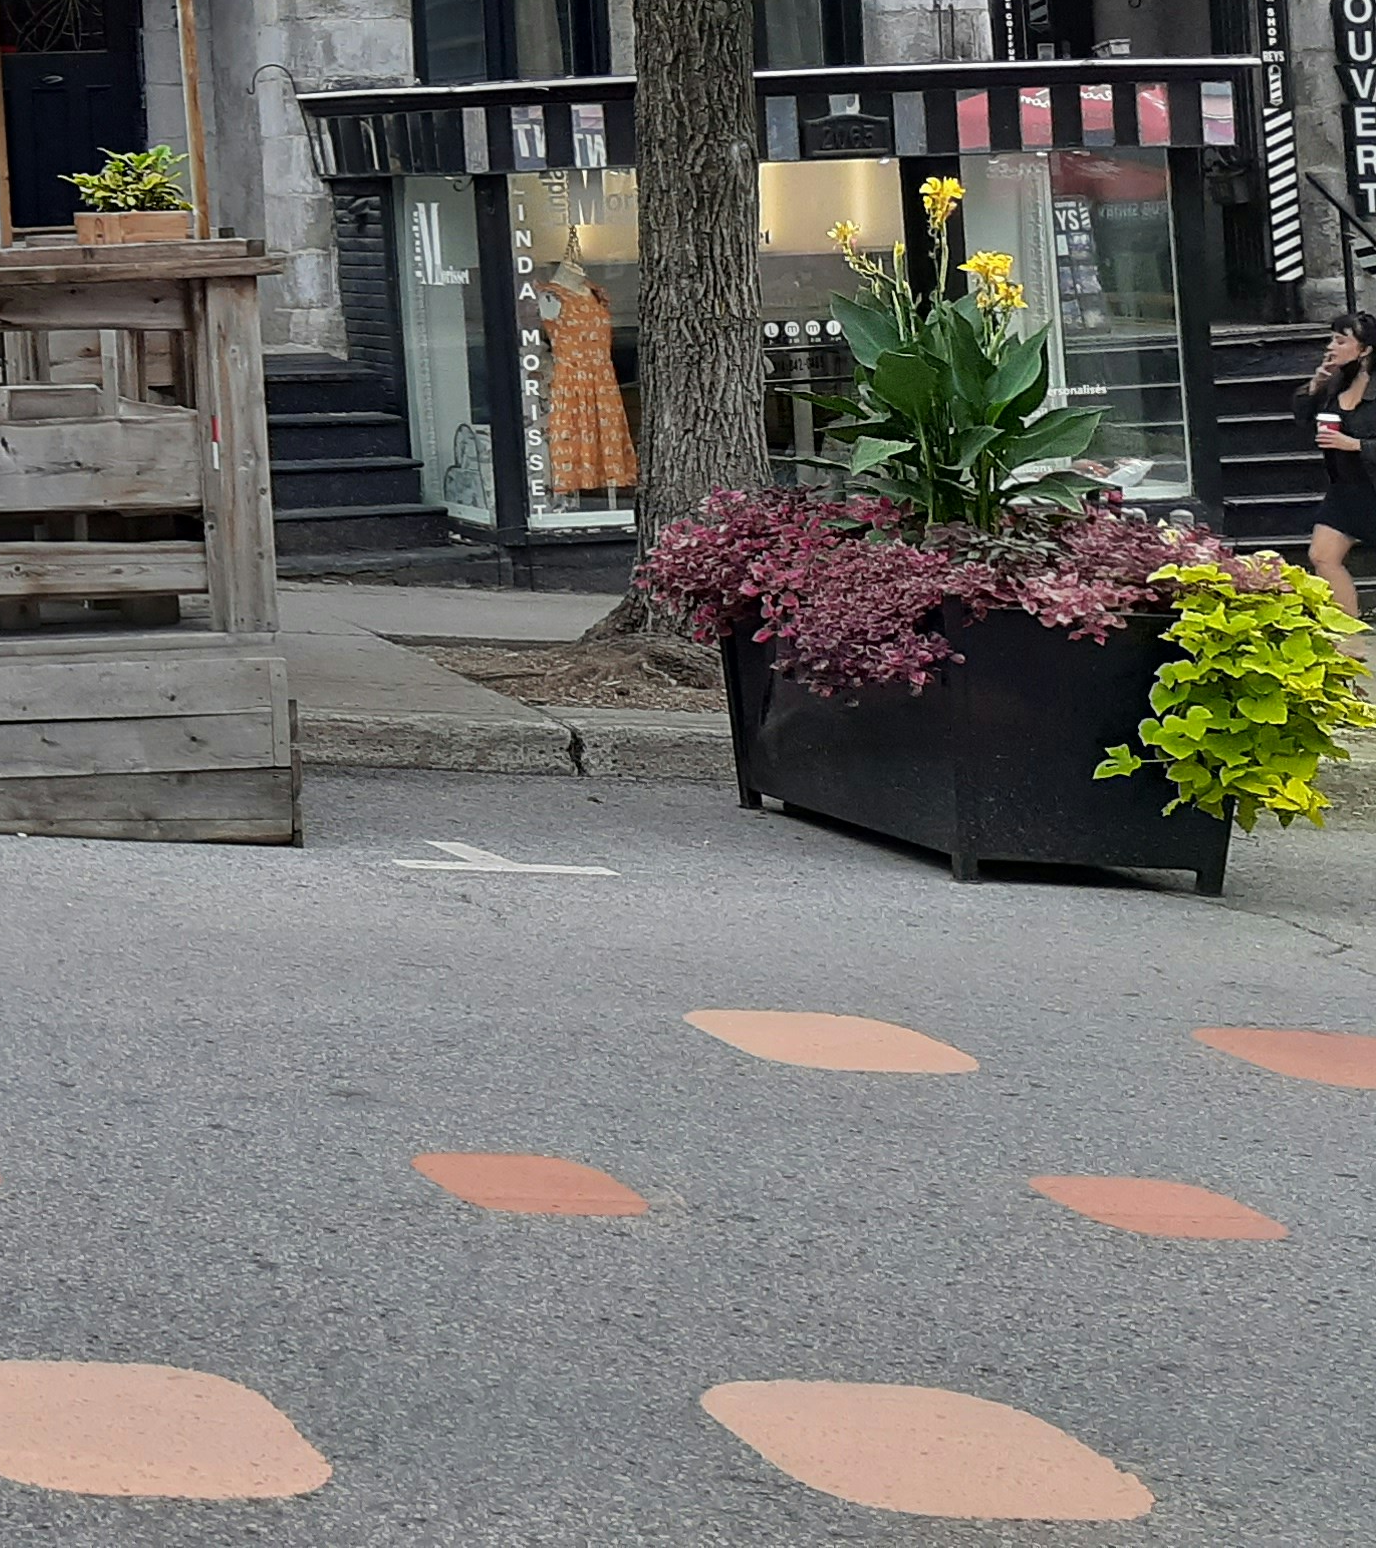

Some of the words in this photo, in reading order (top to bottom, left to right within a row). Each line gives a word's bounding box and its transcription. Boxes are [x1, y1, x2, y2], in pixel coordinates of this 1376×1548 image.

[1005, 12, 1016, 61] COIFFUR
[1266, 7, 1277, 47] SHOP
[1047, 383, 1108, 397] ersonalisés
[521, 329, 548, 521] MORISSET
